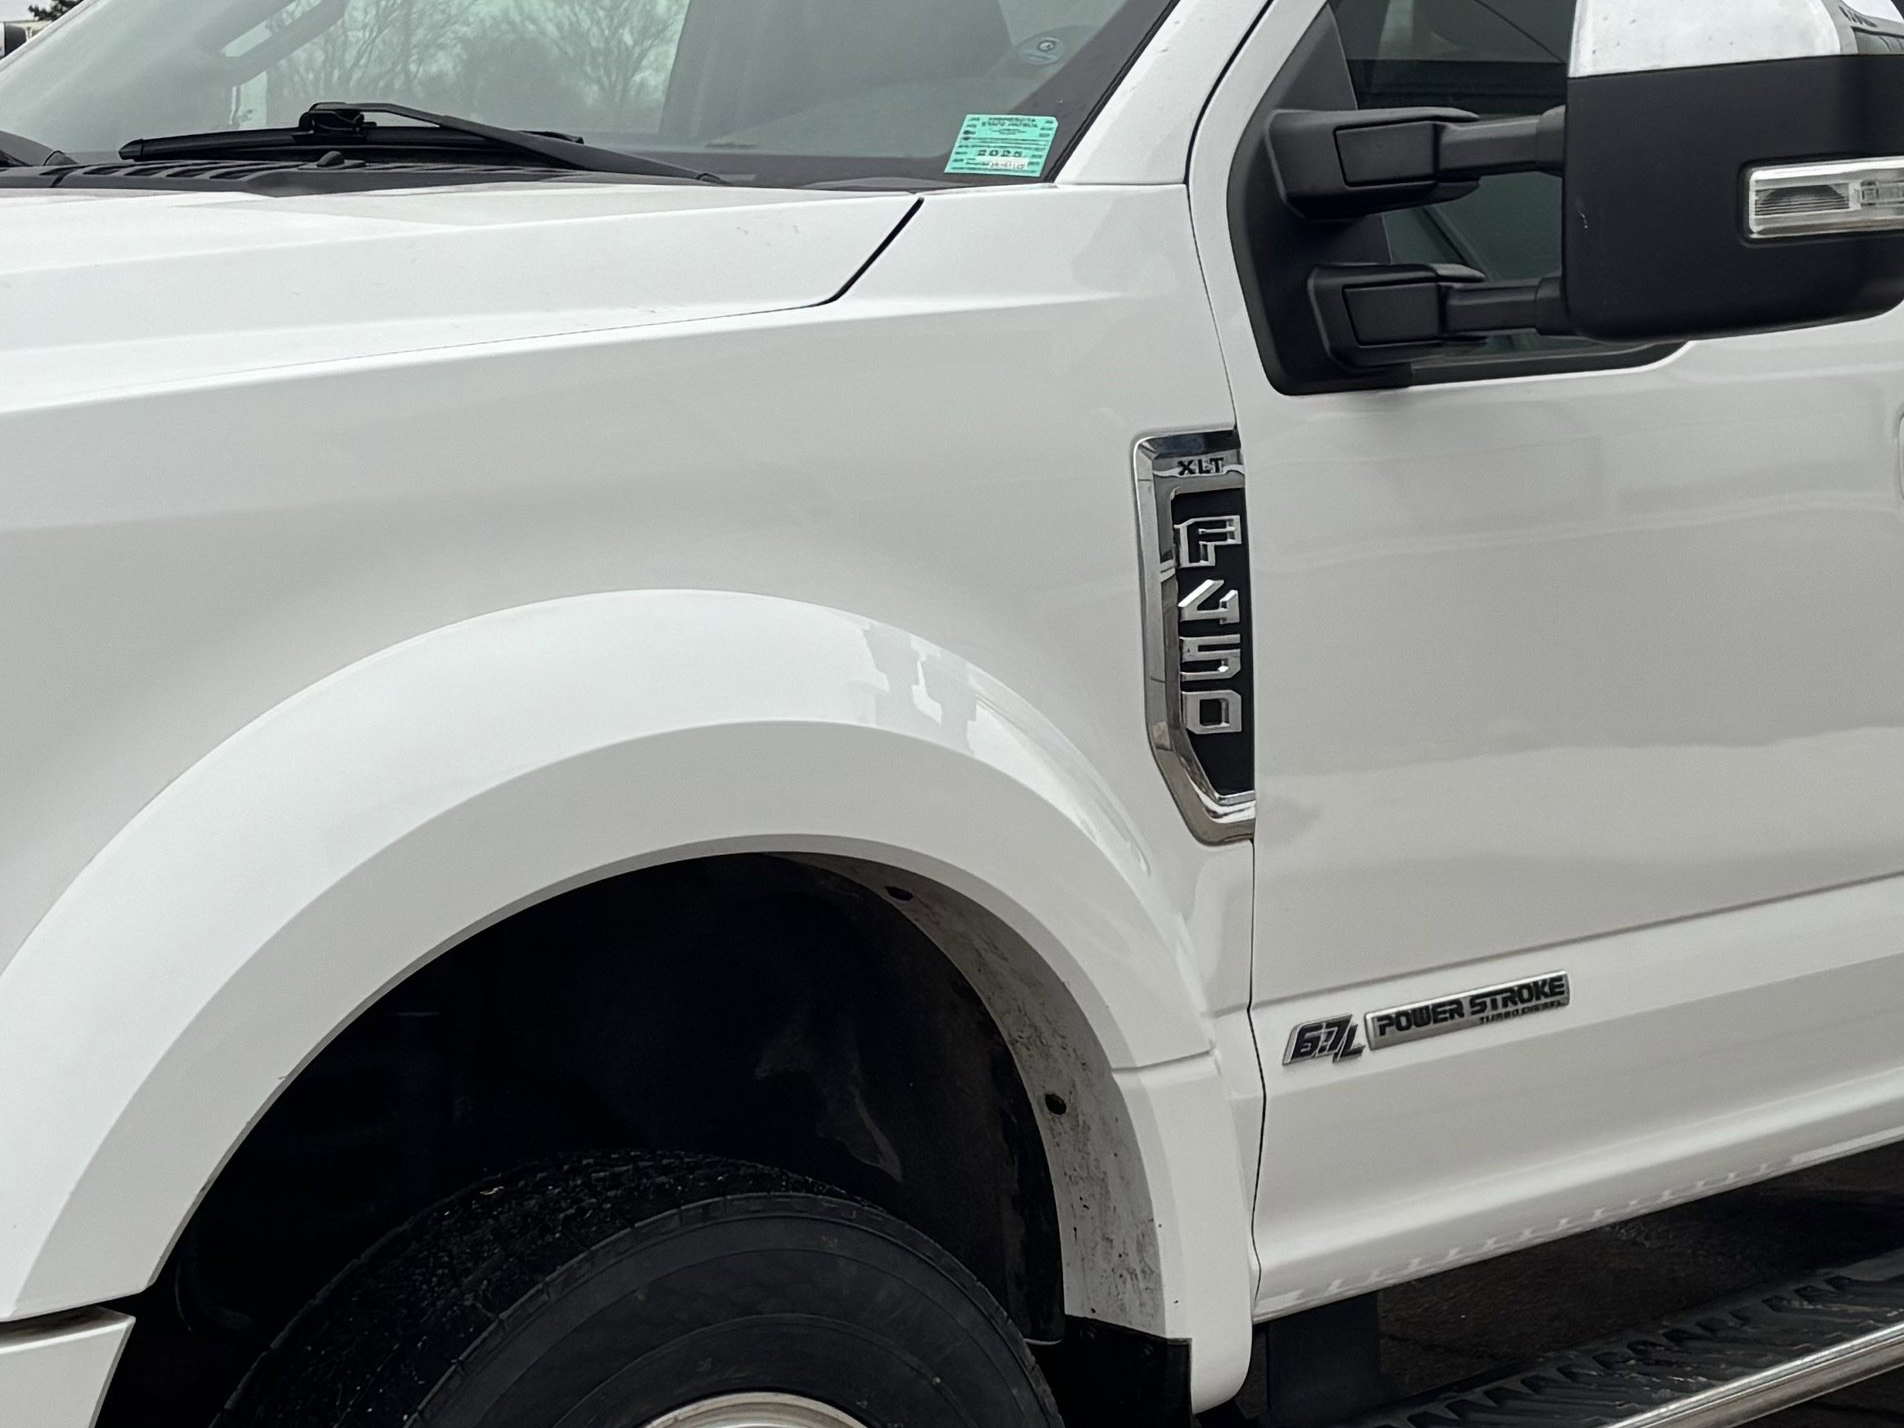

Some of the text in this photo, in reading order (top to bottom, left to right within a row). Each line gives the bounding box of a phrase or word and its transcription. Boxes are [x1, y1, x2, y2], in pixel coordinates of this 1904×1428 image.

[1177, 457, 1224, 475] XLT
[1376, 999, 1466, 1037] POWER
[1469, 976, 1566, 1016] STROKE
